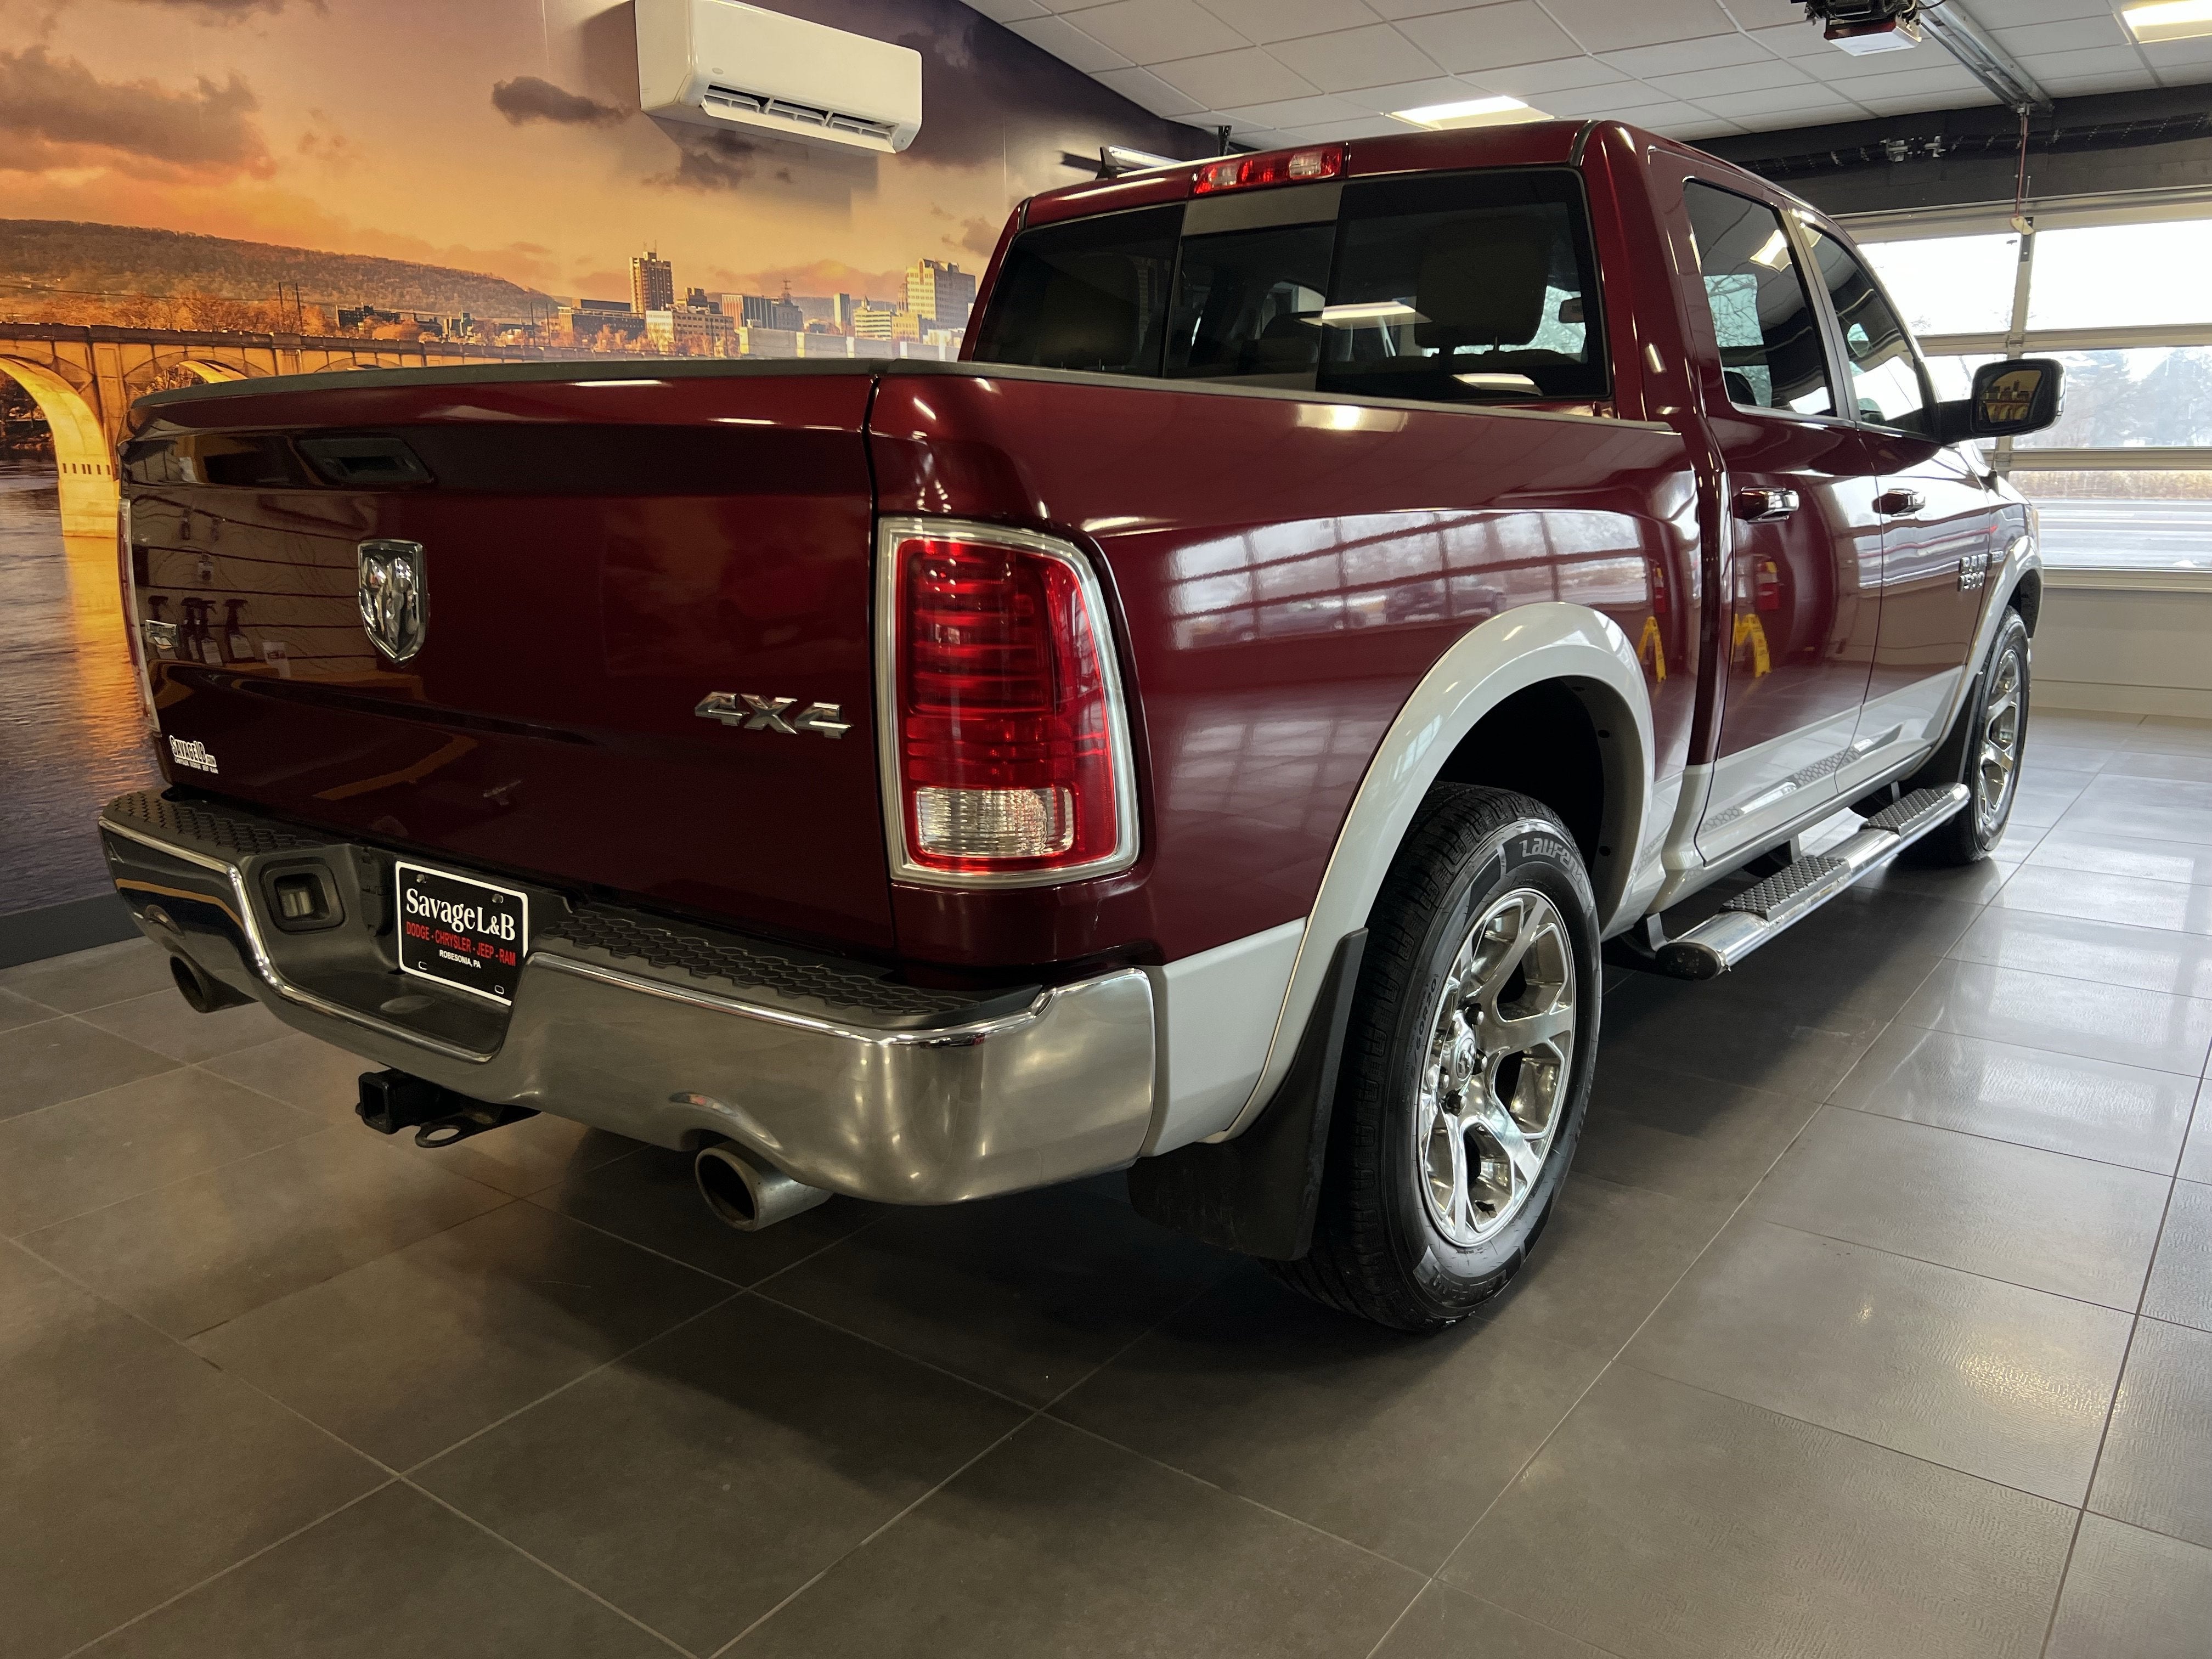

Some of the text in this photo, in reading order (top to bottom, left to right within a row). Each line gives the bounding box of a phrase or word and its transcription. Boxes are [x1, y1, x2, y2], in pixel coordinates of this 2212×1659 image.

[406, 921, 516, 967] DODGE CHRYSLER JEEP RAM
[439, 950, 481, 969] ROBESONIA, PA
